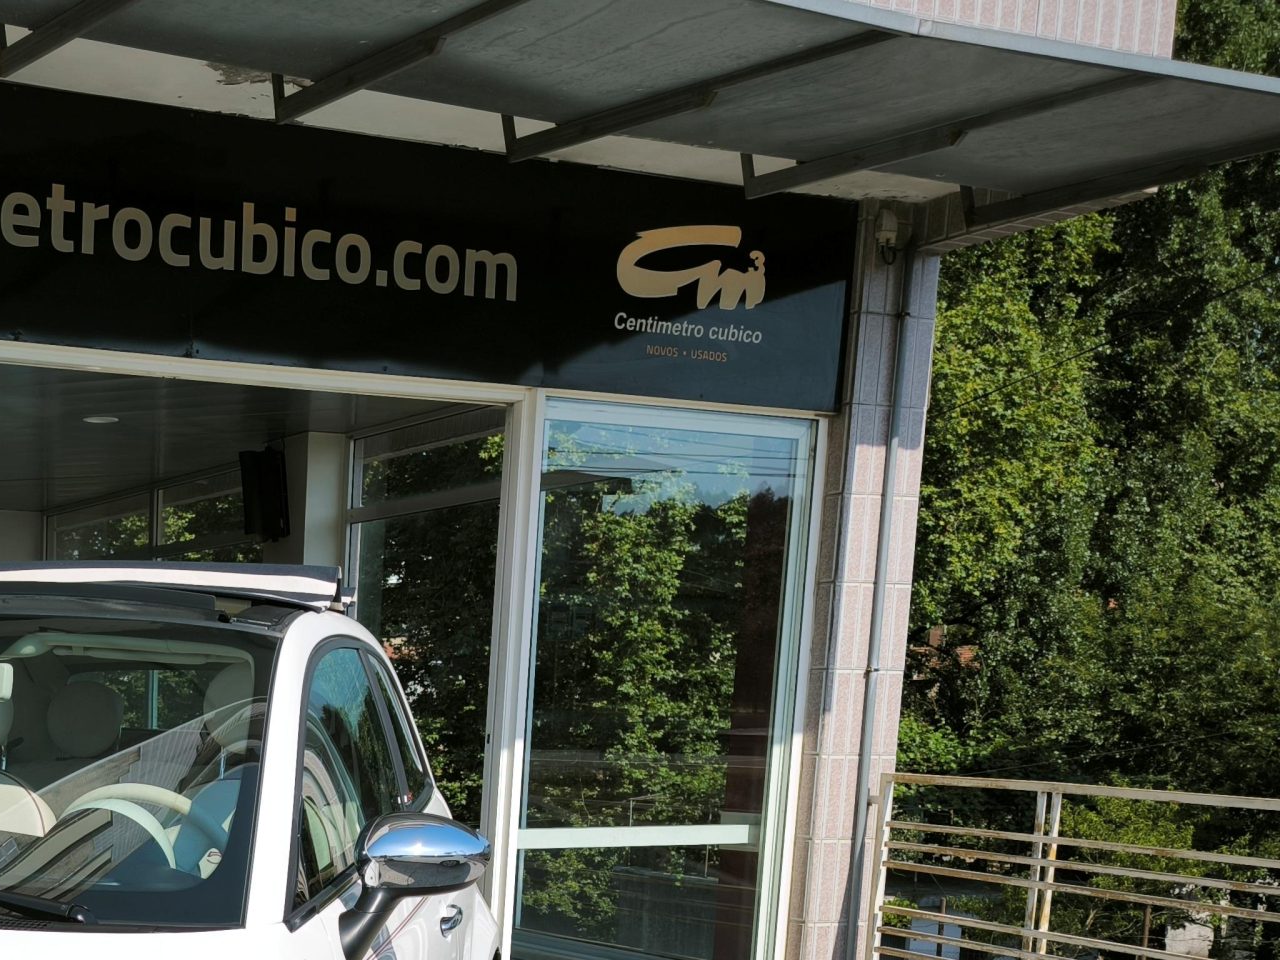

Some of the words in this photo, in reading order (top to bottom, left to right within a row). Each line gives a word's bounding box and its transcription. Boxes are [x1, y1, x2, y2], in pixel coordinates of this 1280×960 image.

[614, 312, 704, 338] Centimetro
[708, 324, 762, 344] cubico
[646, 344, 679, 358] NOVOS
[690, 349, 728, 363] USADOS
